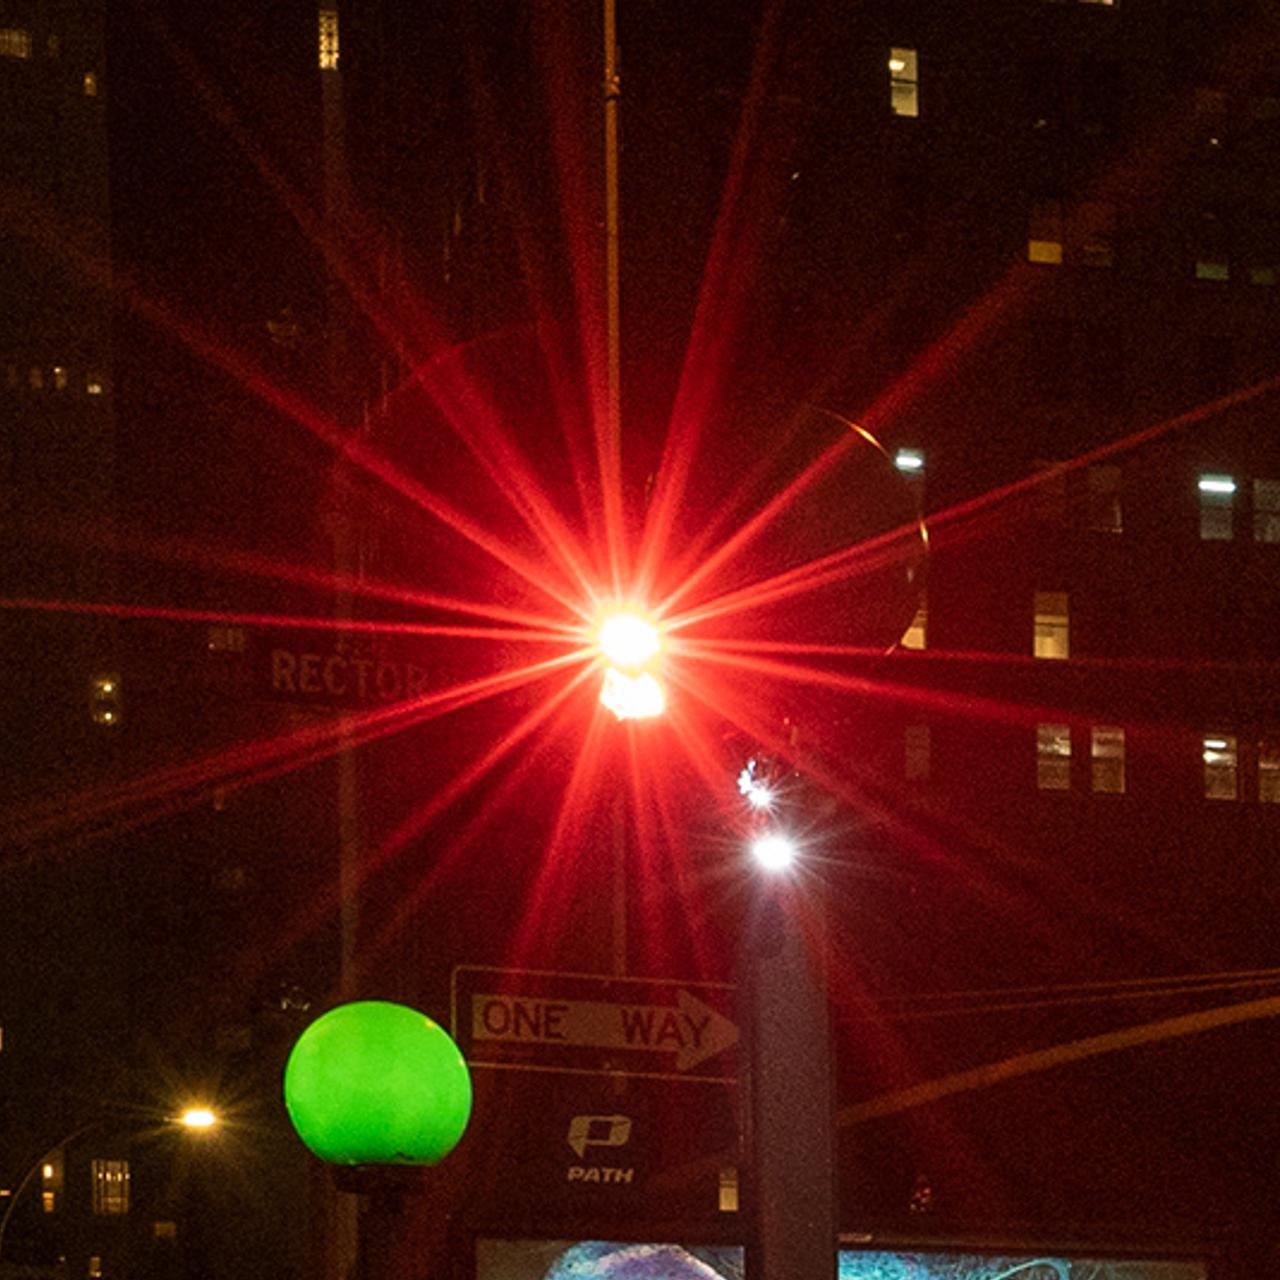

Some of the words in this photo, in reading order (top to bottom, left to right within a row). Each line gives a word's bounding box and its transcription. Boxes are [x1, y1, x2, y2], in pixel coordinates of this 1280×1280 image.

[270, 649, 430, 700] RECTOR
[483, 1000, 569, 1039] ONE
[622, 1009, 711, 1049] WAY
[566, 1165, 635, 1184] PATH
